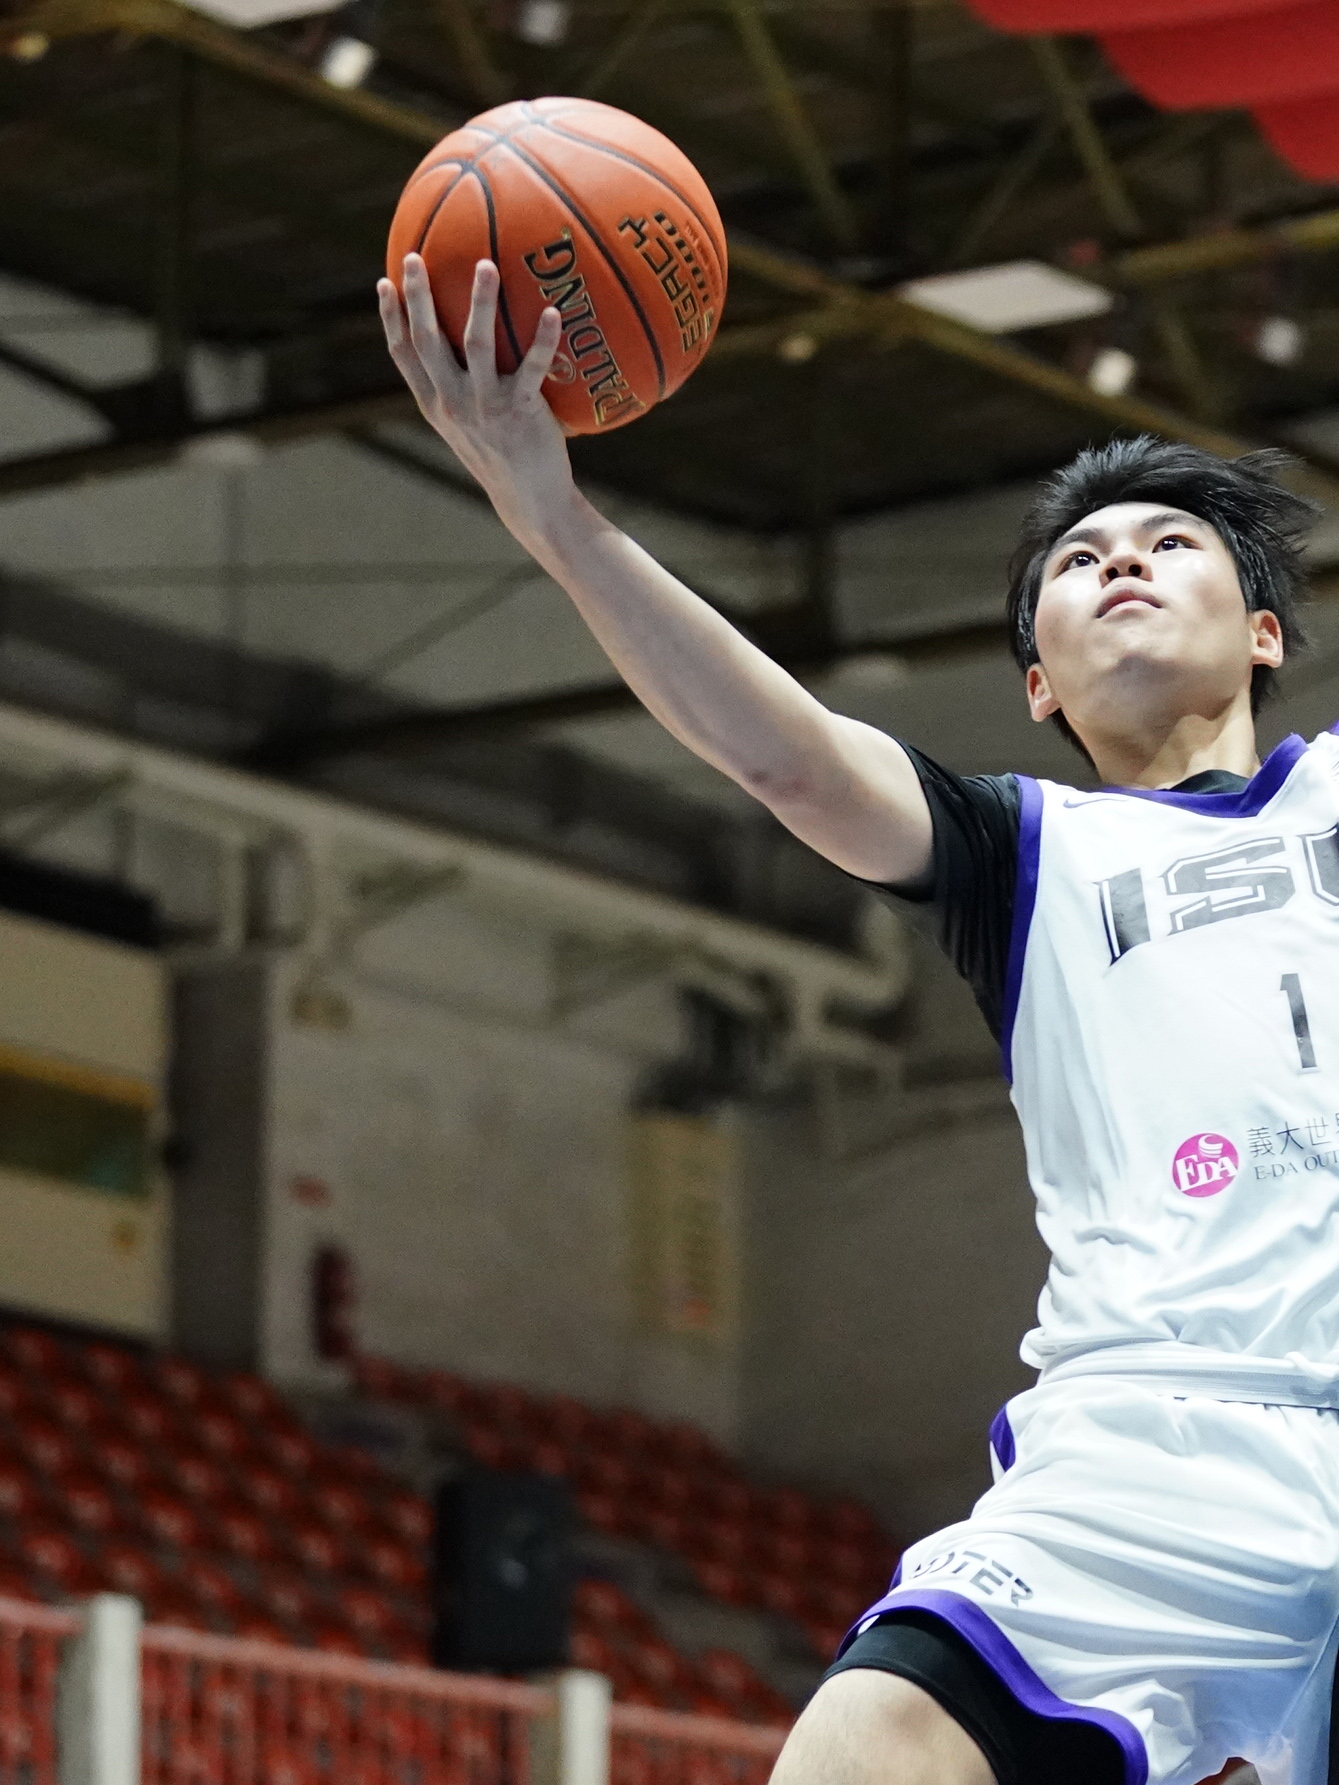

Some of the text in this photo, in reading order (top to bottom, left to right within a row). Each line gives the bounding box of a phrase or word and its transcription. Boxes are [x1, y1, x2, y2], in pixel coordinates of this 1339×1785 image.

[617, 215, 702, 353] EGACY
[1280, 972, 1319, 1074] 1
[1175, 1155, 1237, 1192] EDA
[1254, 1161, 1299, 1180] E-DA
